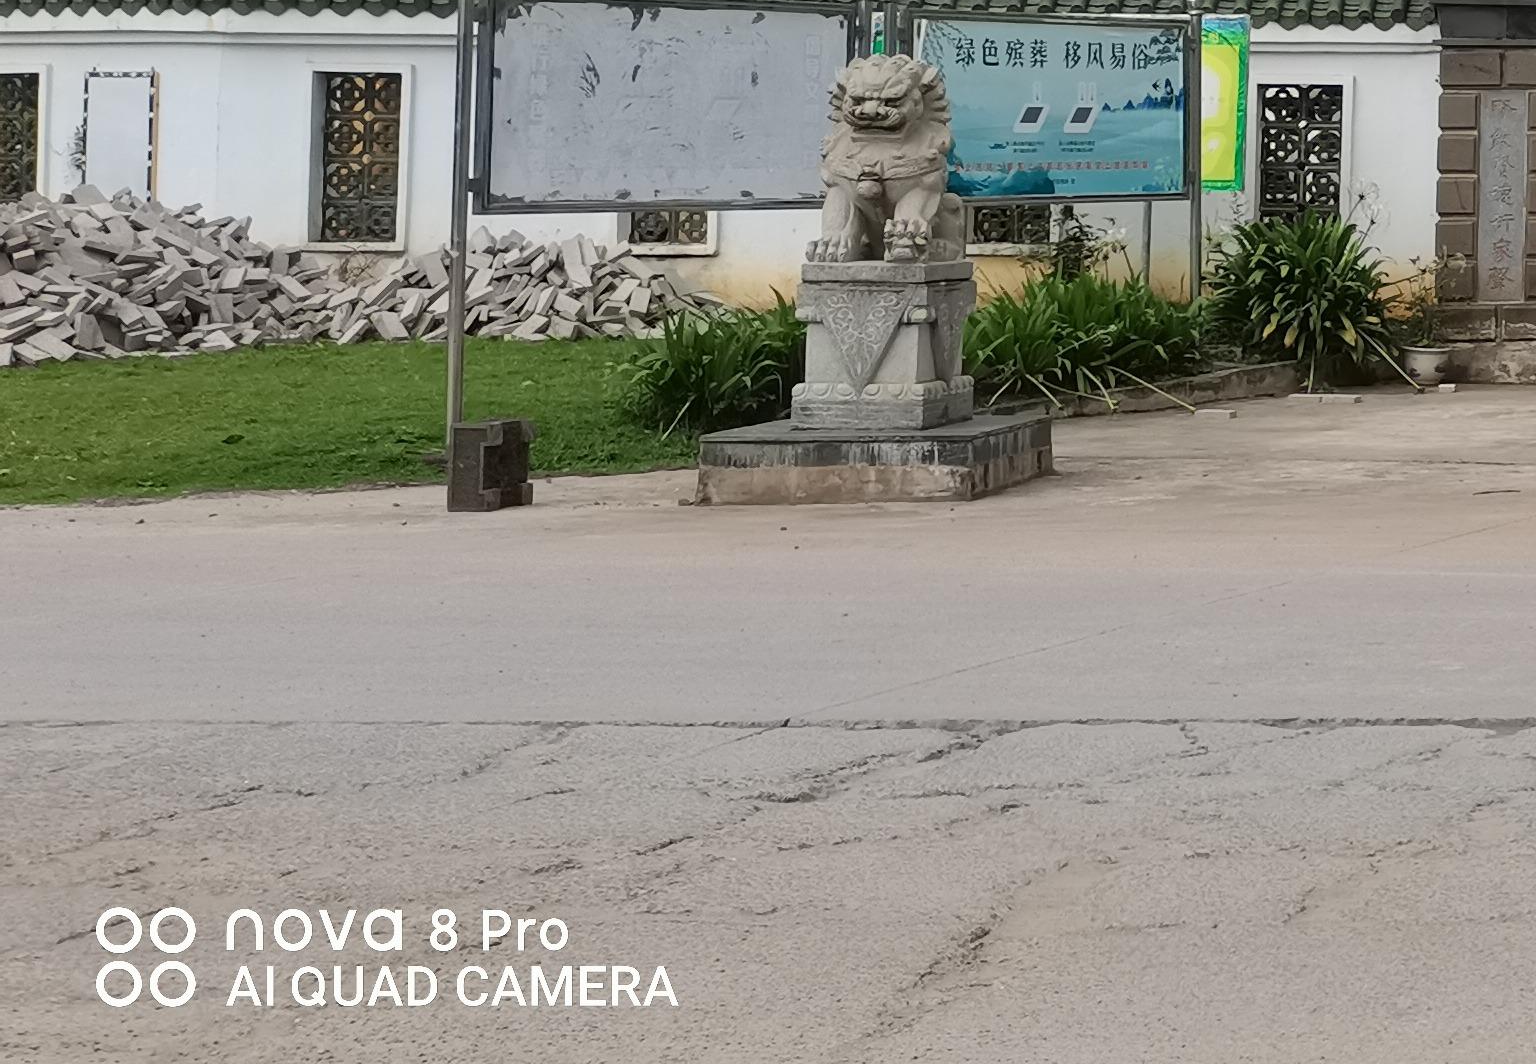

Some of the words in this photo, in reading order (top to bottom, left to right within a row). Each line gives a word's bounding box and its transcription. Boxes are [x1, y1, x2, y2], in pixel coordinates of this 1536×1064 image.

[955, 38, 1049, 68] 绿色殡葬
[1064, 40, 1149, 70] 移风易俗
